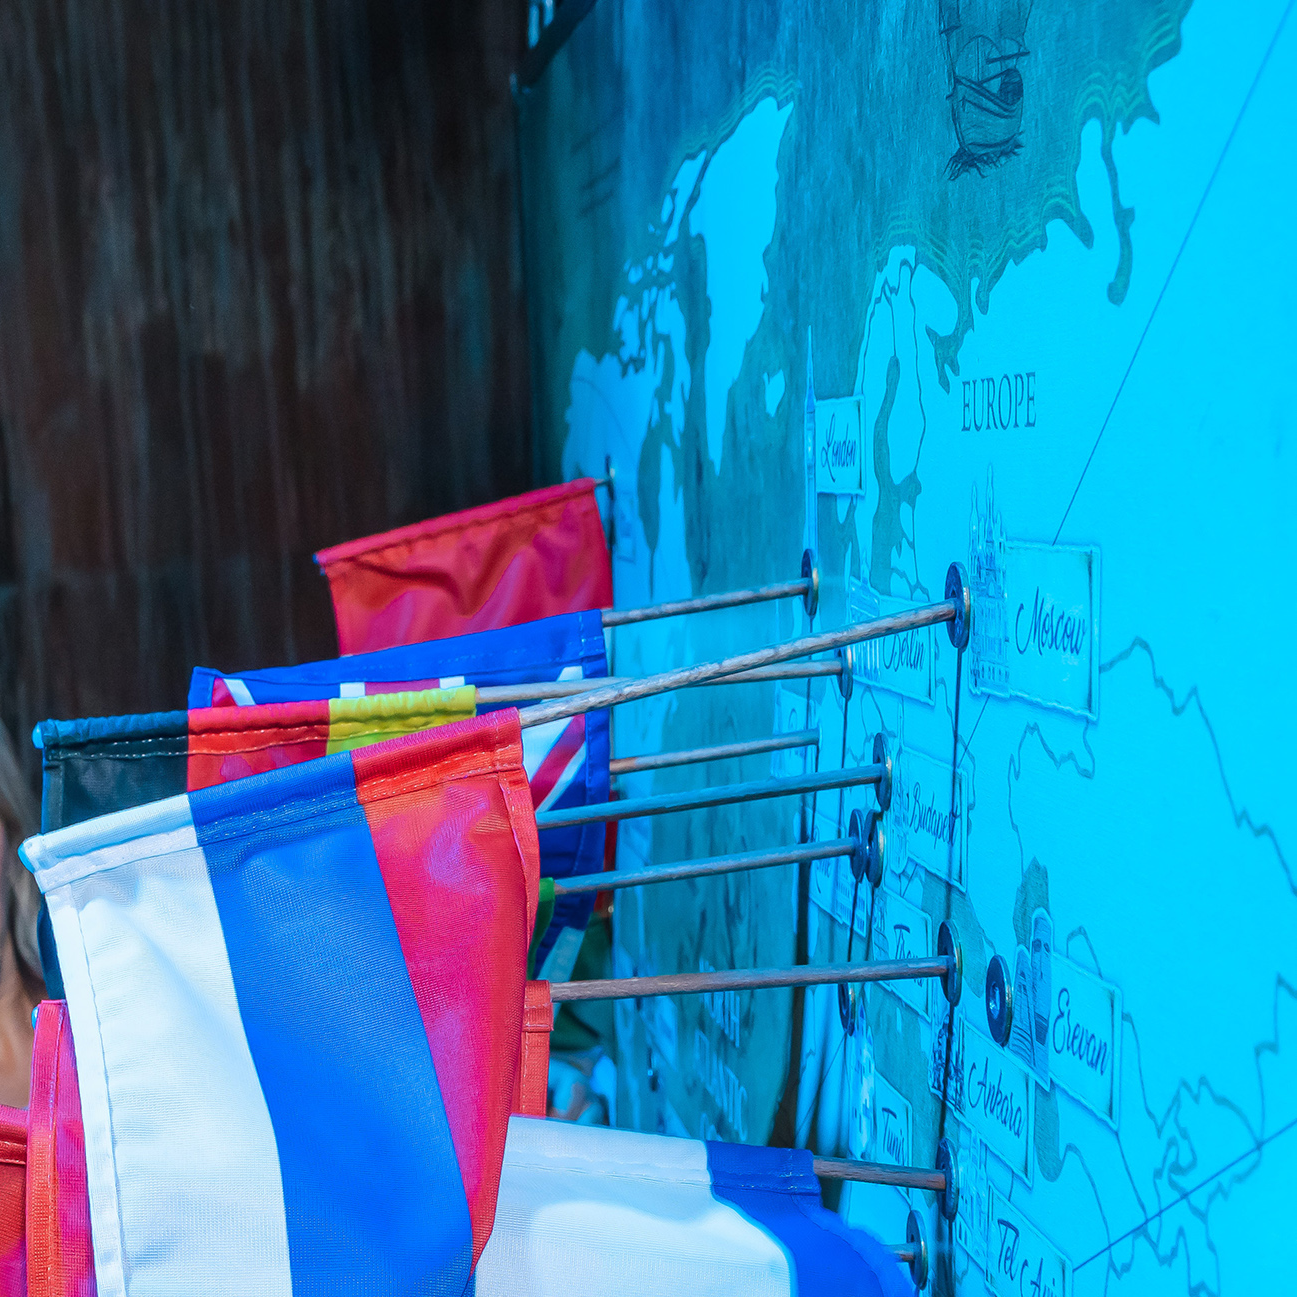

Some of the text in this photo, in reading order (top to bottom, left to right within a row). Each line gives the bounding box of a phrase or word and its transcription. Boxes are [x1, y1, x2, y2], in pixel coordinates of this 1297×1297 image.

[961, 371, 1037, 432] EUROPE
[820, 412, 857, 483] London
[1015, 586, 1086, 656] Moscow
[1052, 987, 1109, 1076] Erevan
[968, 1056, 1024, 1139] Ankara
[998, 1218, 1020, 1281] Tel
